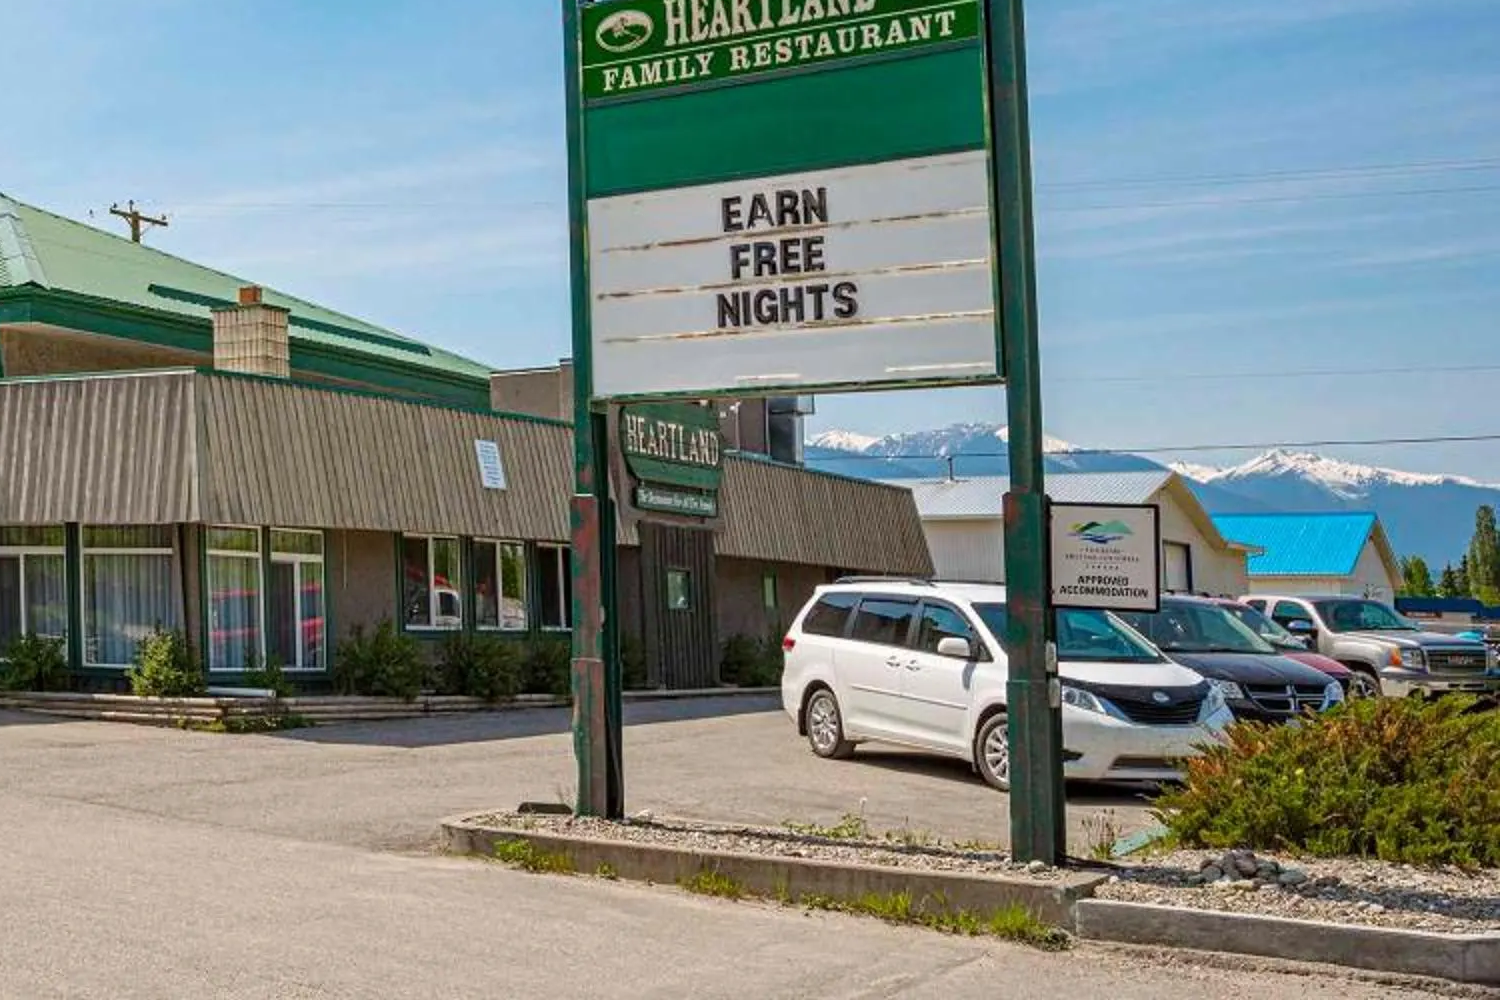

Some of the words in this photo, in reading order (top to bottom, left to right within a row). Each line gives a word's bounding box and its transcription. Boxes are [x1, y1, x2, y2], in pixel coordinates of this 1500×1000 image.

[602, 51, 714, 92] FAMILY
[729, 10, 956, 72] RESTAURANT
[721, 187, 829, 232] EARN
[729, 235, 826, 280] FREE
[716, 281, 859, 328] NIGHTS
[626, 414, 719, 466] HEARTLAND
[1078, 575, 1129, 586] APPROVED
